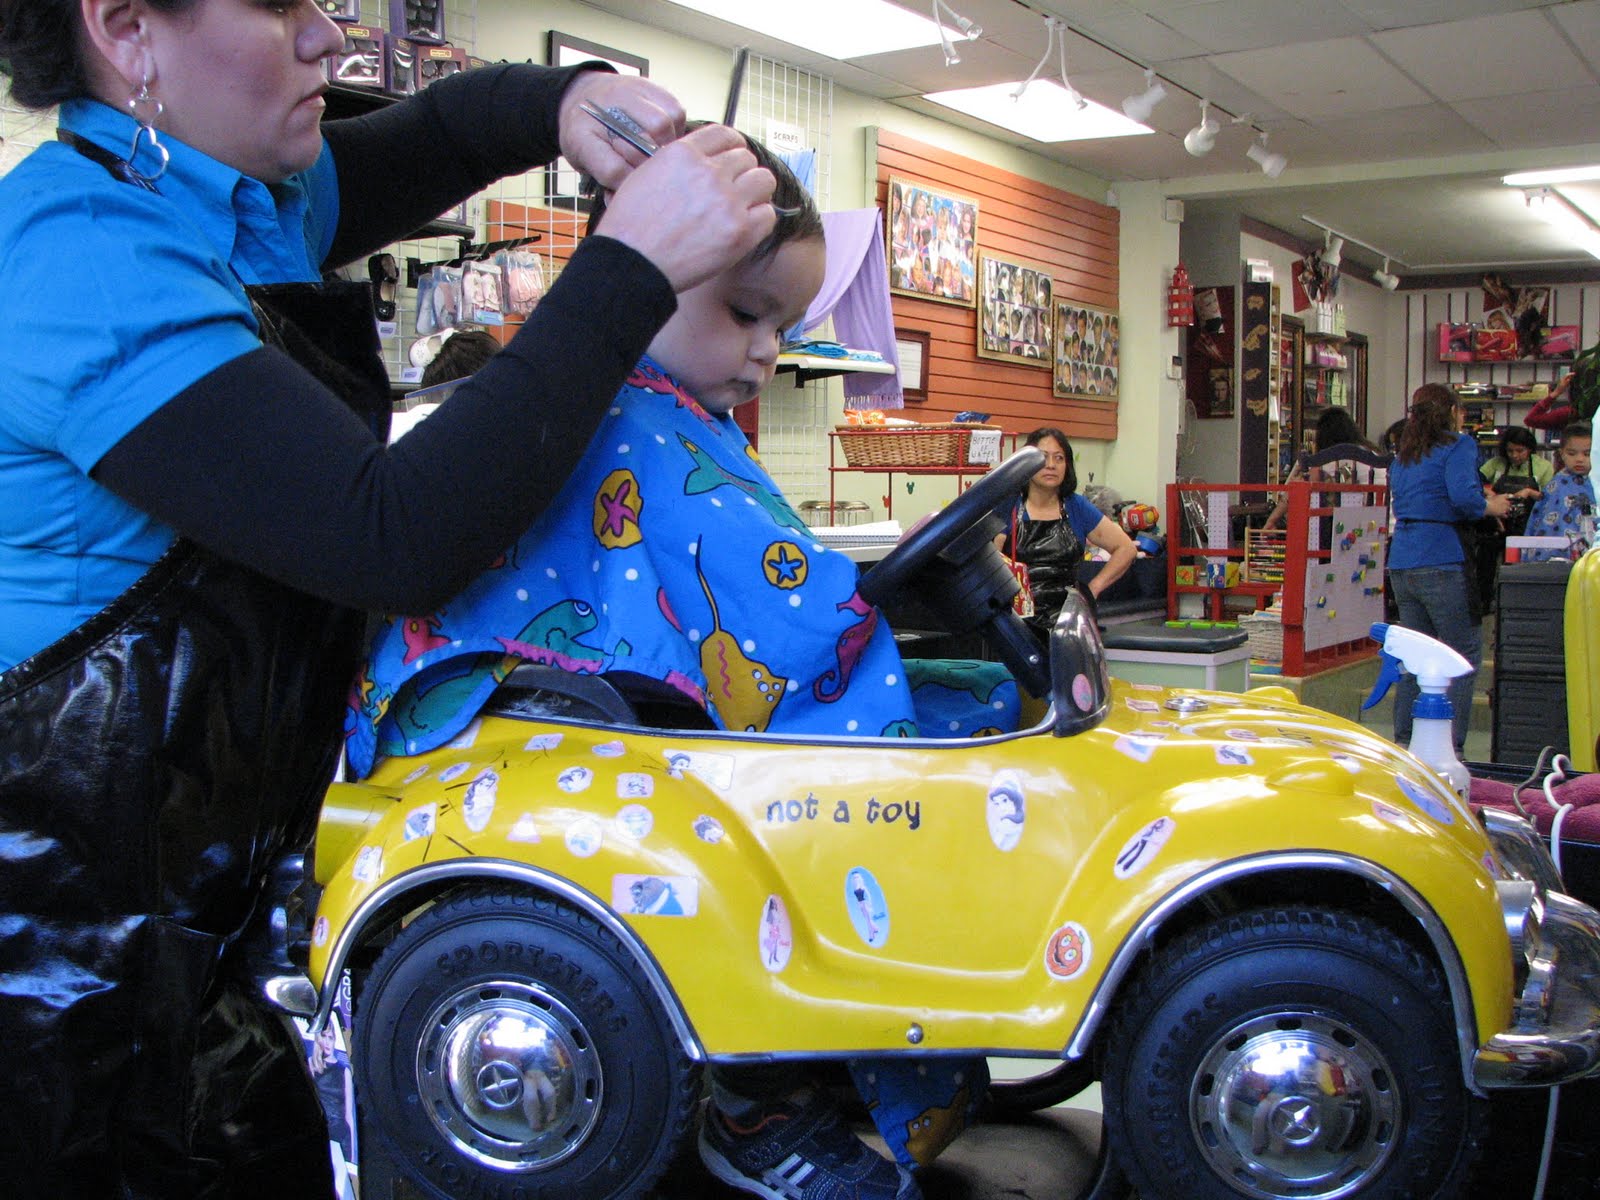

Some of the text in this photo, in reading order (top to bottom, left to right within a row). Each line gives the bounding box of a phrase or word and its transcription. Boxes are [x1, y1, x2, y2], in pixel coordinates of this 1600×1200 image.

[767, 791, 920, 831] not a toy
[435, 940, 628, 1034] SPORTSTERS
